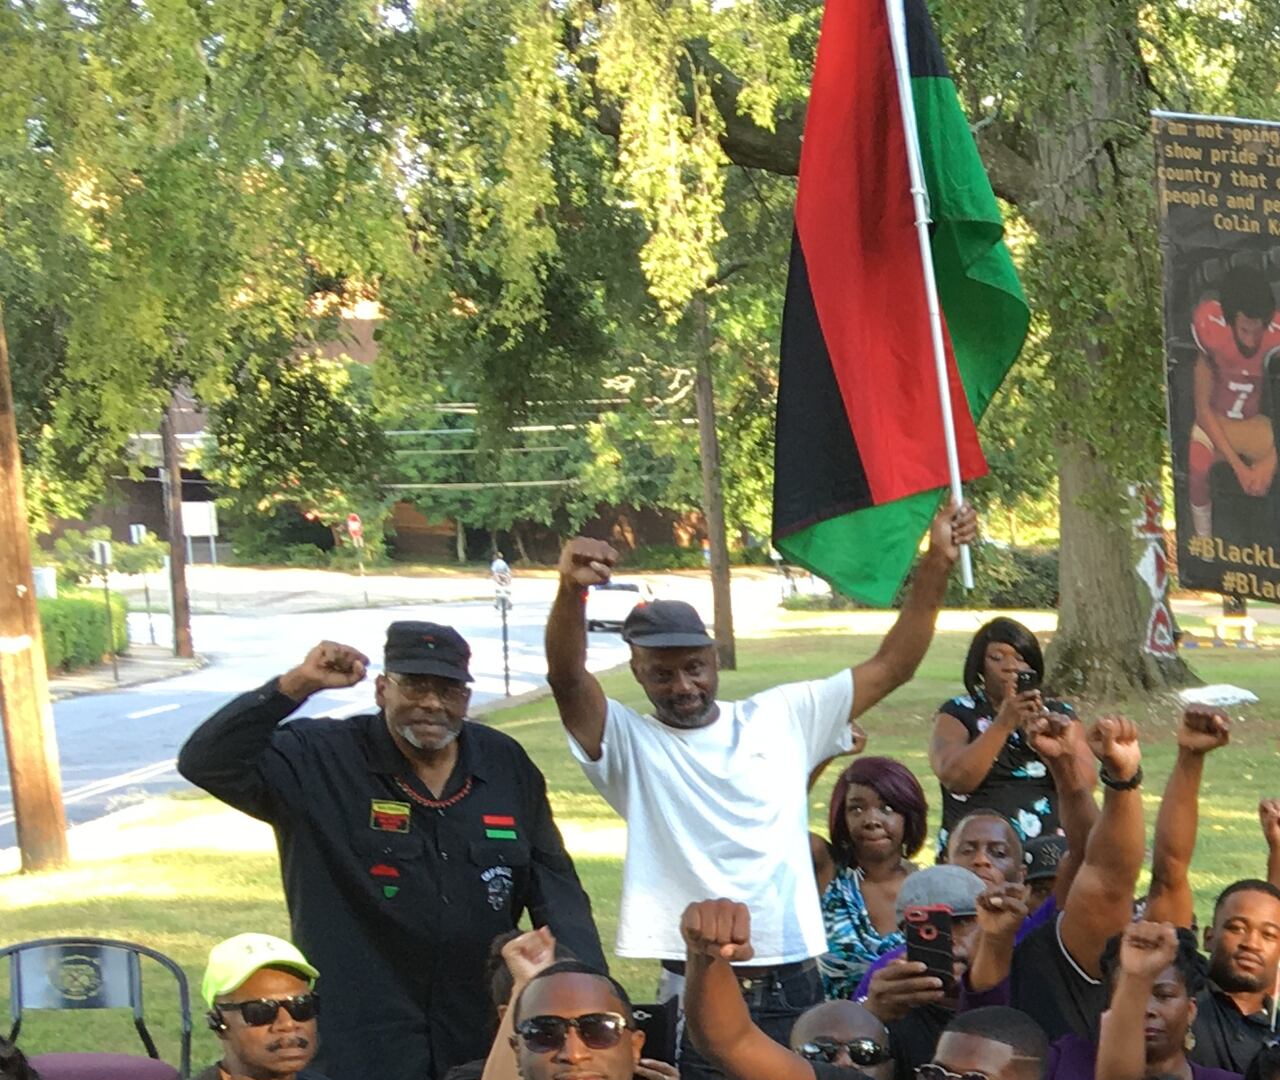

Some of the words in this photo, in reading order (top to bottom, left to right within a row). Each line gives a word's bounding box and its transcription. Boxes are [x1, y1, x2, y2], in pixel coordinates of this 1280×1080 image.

[1168, 121, 1187, 137] am
[1195, 123, 1224, 140] not
[1233, 125, 1280, 147] going
[1165, 142, 1203, 161] show
[1211, 146, 1258, 166] pride
[1158, 166, 1221, 189] country
[1231, 170, 1267, 189] that
[1162, 189, 1218, 208] people
[1226, 194, 1255, 211] and
[1213, 213, 1261, 235] Colin
